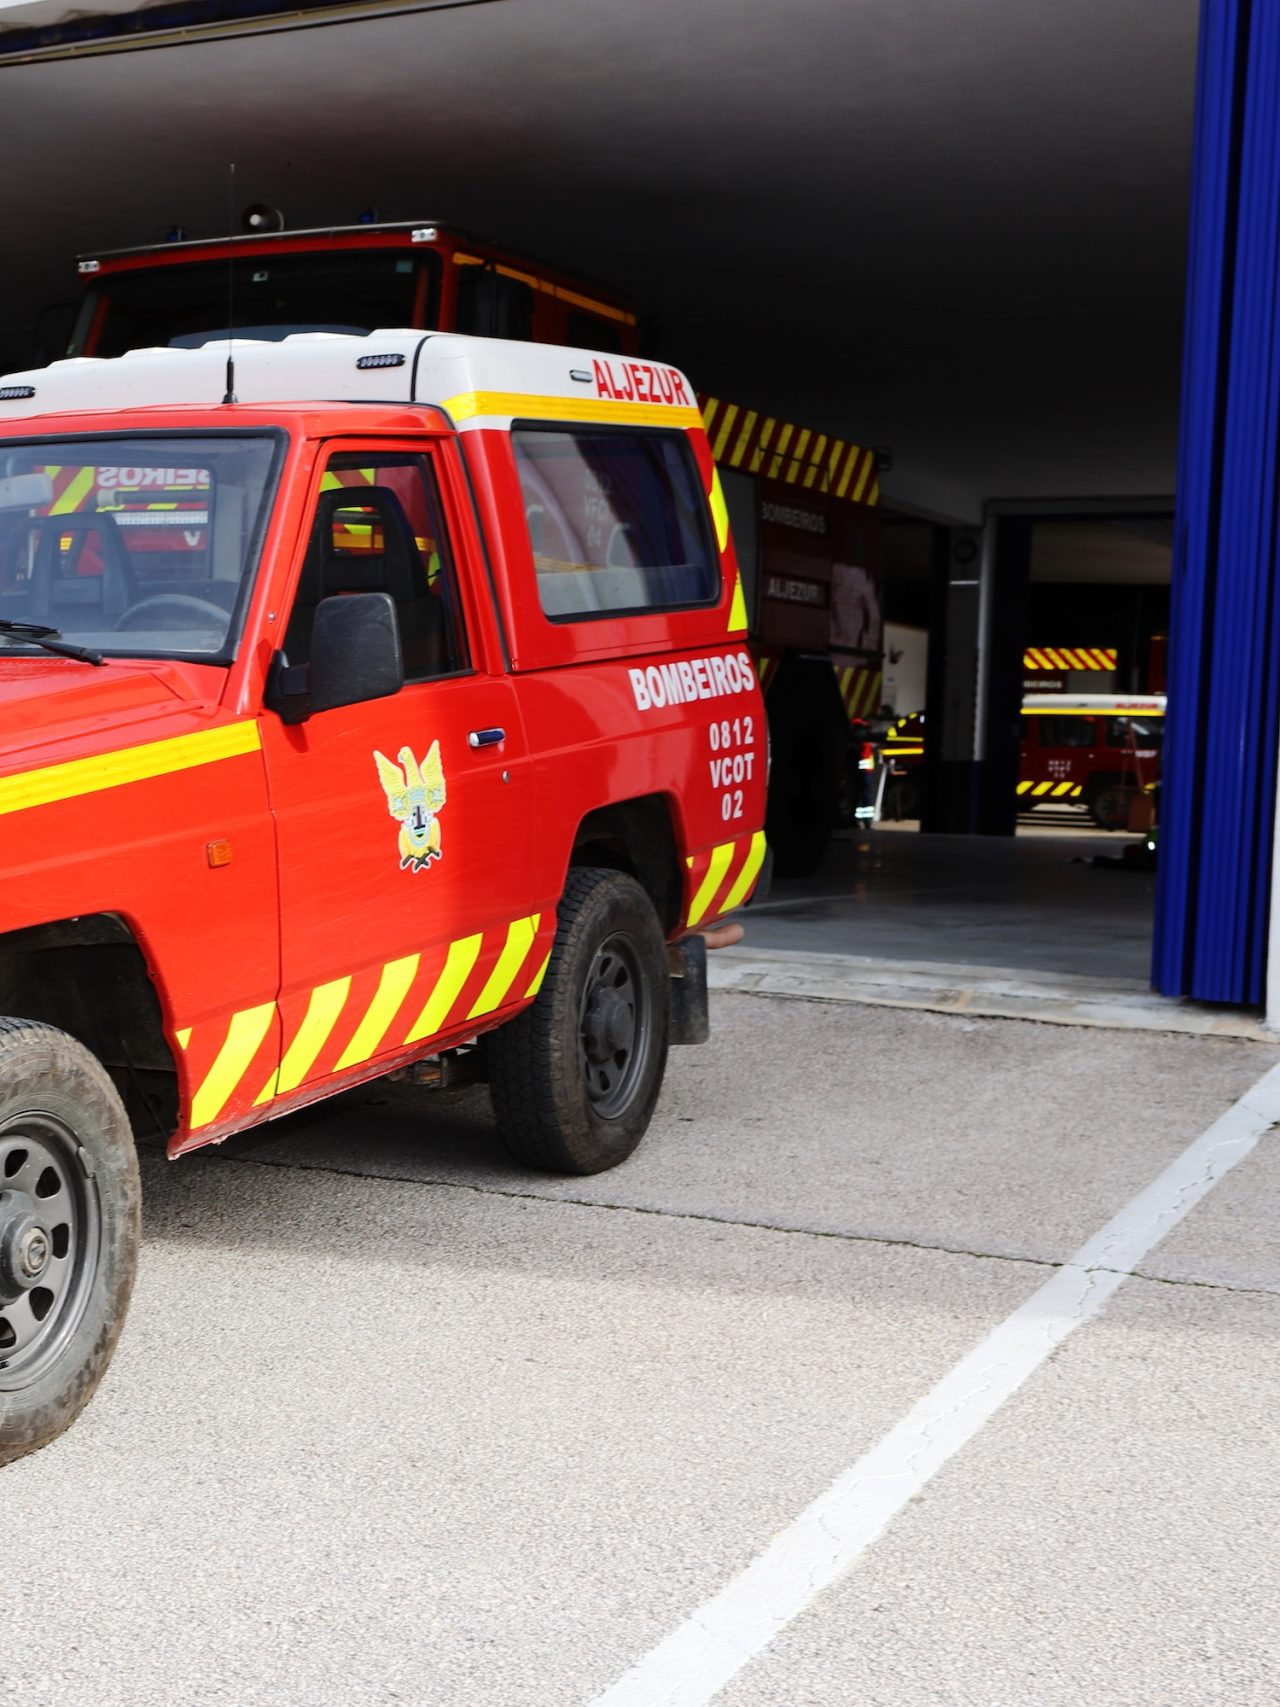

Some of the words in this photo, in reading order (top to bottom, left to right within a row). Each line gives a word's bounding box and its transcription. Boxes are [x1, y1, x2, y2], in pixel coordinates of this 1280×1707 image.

[592, 359, 690, 406] ALJEZUR
[767, 576, 819, 602] ALJEZUR
[627, 652, 755, 711] BOMBEIROS
[709, 716, 754, 751] 0812
[709, 752, 755, 789] VCOT
[721, 789, 744, 821] 02
